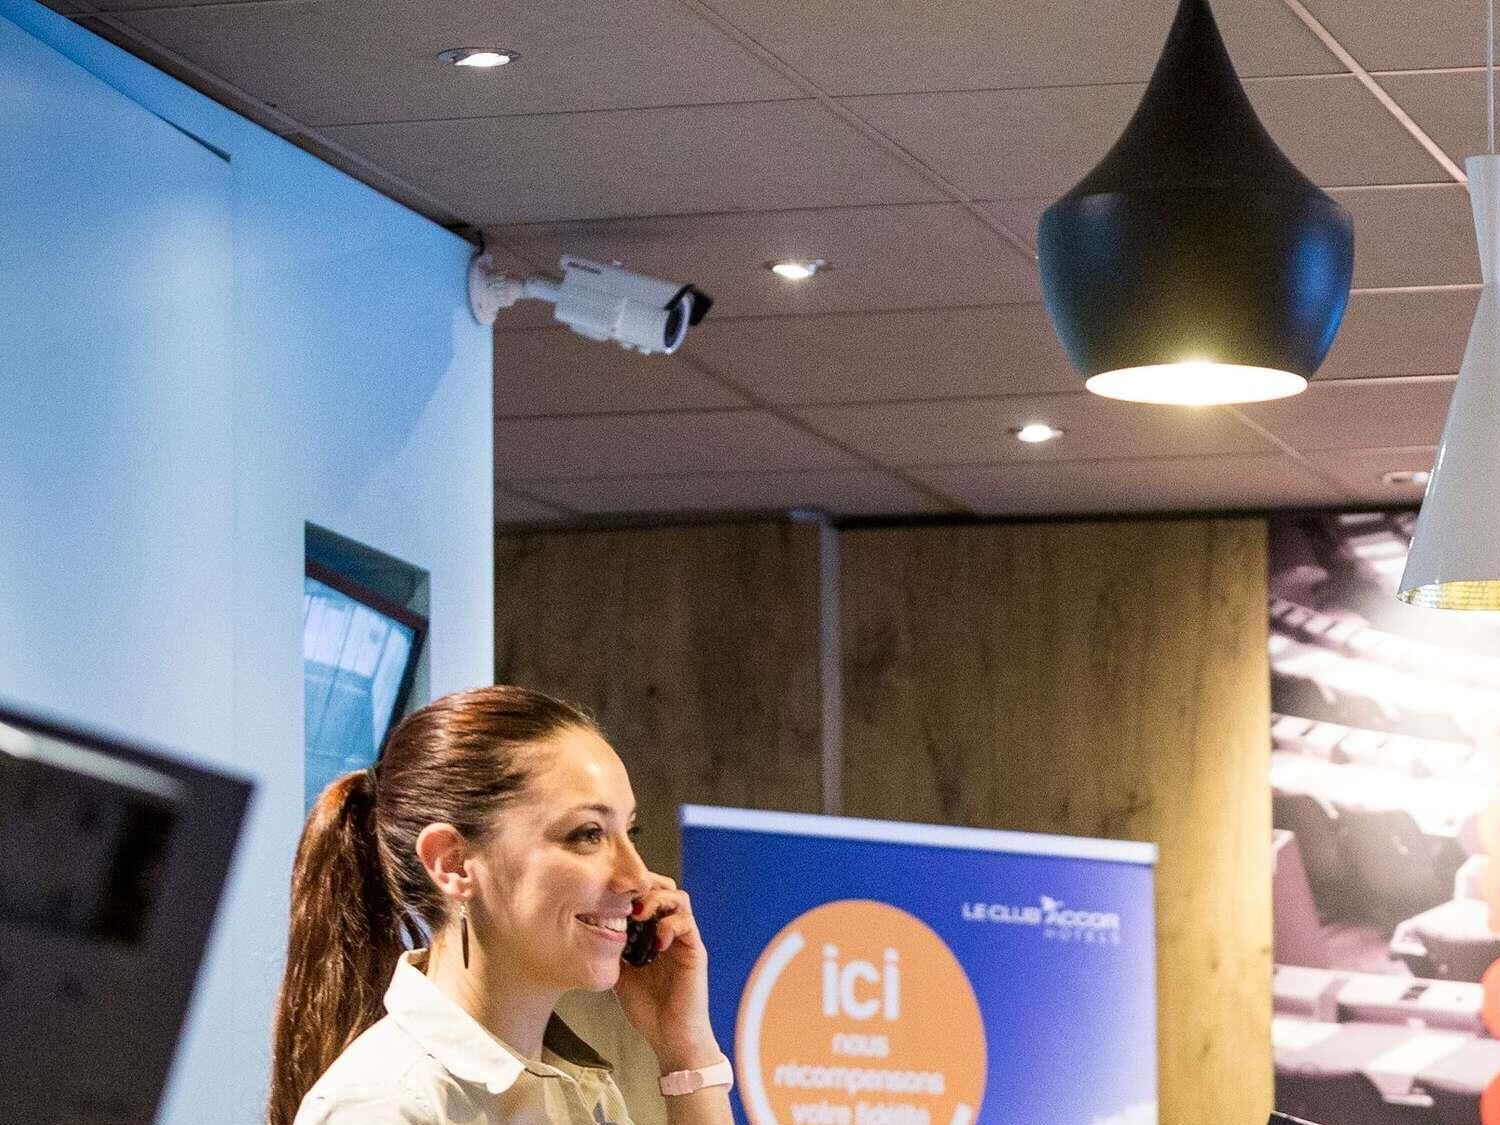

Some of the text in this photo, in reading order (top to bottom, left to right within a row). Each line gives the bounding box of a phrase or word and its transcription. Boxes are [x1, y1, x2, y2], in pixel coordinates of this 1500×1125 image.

[961, 902, 987, 921] LE
[988, 904, 1041, 926] CLUB
[822, 943, 900, 1021] ici
[831, 1033, 890, 1058] nous
